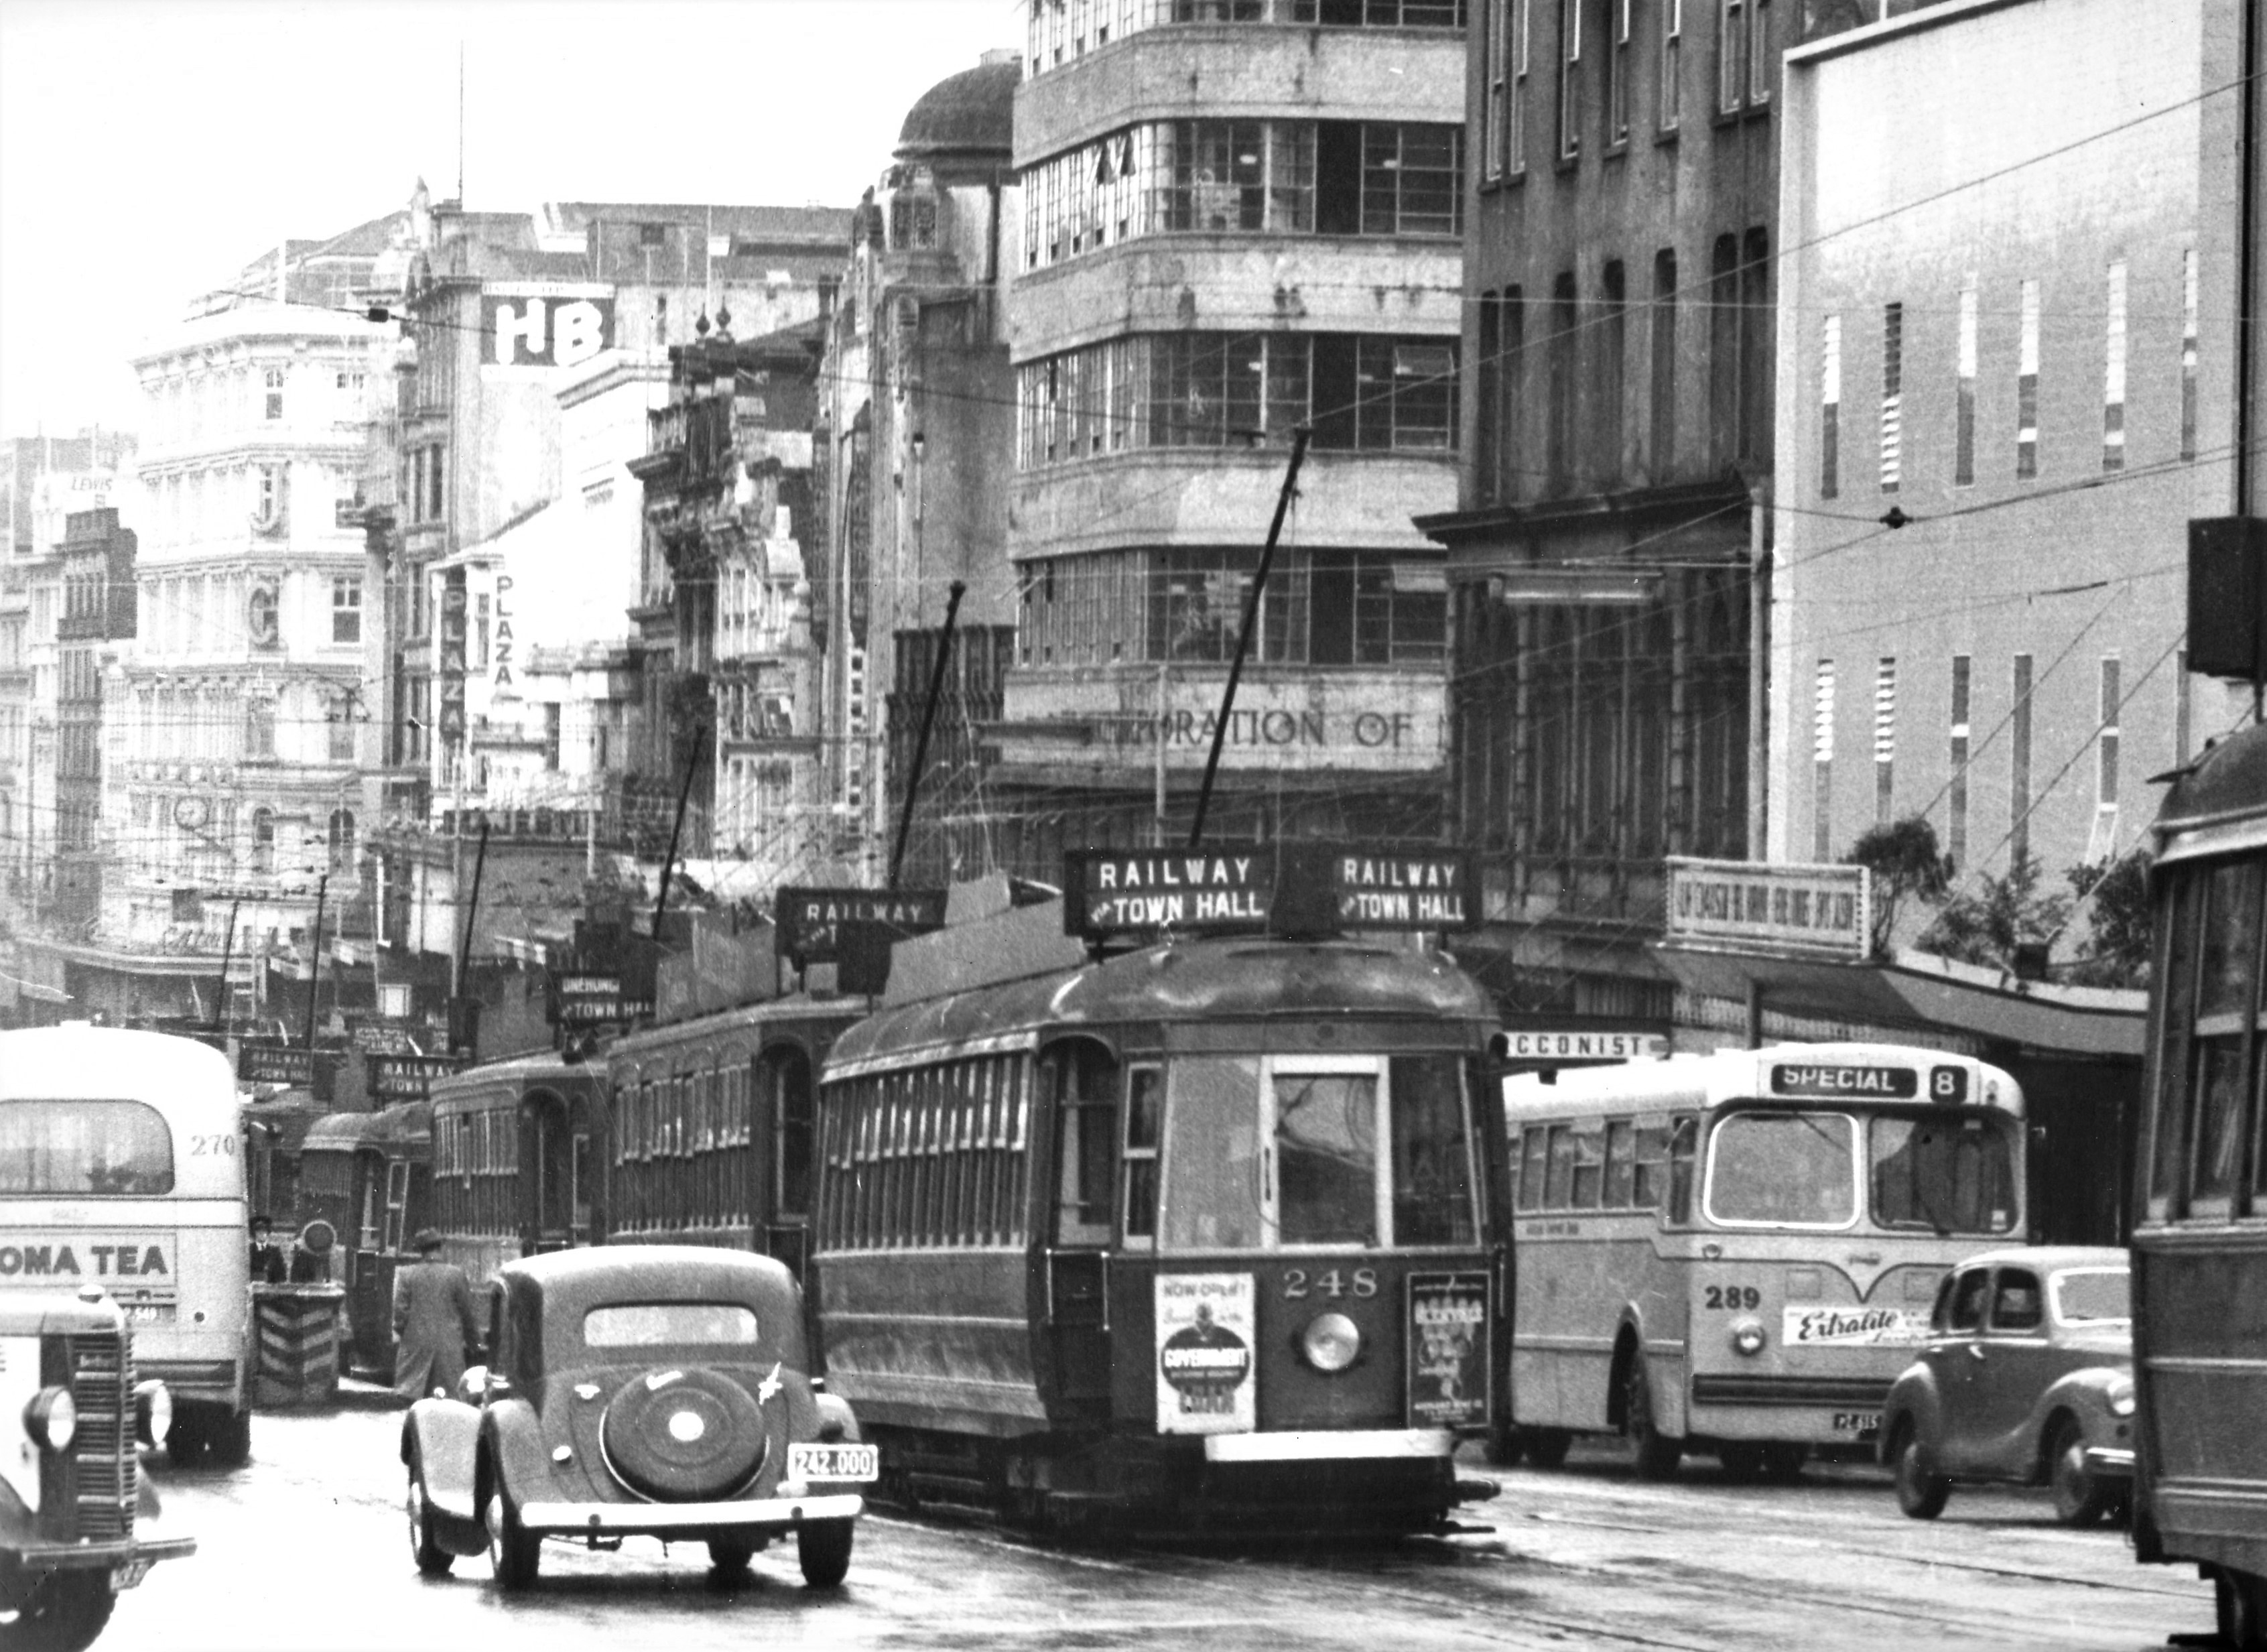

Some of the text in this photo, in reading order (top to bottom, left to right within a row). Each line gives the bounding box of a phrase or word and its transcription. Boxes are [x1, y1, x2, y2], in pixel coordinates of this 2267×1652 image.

[495, 298, 603, 368] HB
[495, 575, 514, 685] PLAZA
[445, 591, 464, 728] PLAZA
[1355, 712, 1412, 748] OF
[1100, 858, 1250, 889] RAILWAY
[1344, 859, 1455, 887] RAILWAY
[807, 904, 922, 923] RAILWAY
[1113, 895, 1183, 925] TOWN
[1196, 891, 1265, 919] HALL
[1357, 893, 1409, 920] TOWN
[1417, 893, 1466, 922] HALL
[575, 1003, 617, 1019] TOWN
[1517, 1035, 1641, 1056] CCONIST
[384, 1063, 455, 1078] RAILWAY
[1784, 1068, 1955, 1095] SPECIAL 8
[390, 1078, 423, 1092] TOWN
[192, 1134, 235, 1156] 270
[0, 1246, 169, 1275] OMA TEA
[1283, 1268, 1377, 1297] 248
[1705, 1286, 1761, 1310] 289
[1165, 1348, 1246, 1367] GOVERNMENT
[796, 1451, 871, 1475] 242.000
